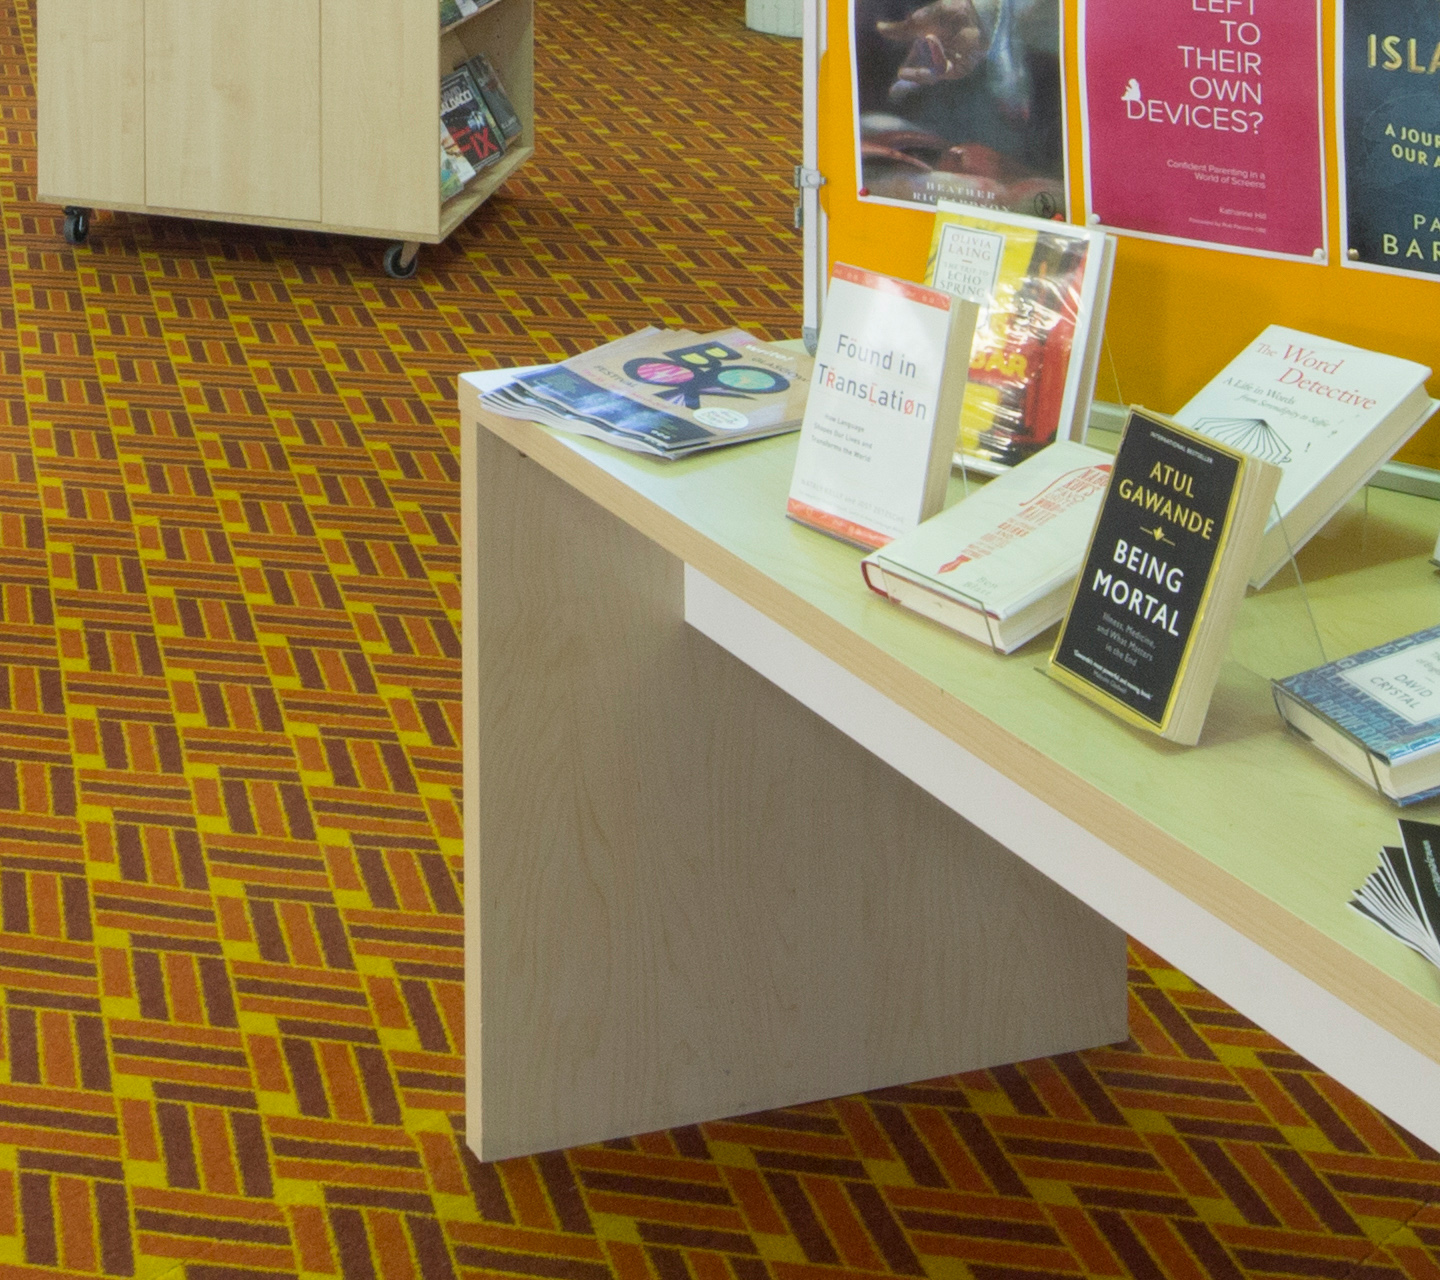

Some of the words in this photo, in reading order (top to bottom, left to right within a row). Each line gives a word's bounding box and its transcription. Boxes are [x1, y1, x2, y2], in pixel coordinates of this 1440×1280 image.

[1219, 20, 1261, 45] TO
[1178, 46, 1262, 75] THEIR
[1189, 76, 1262, 105] OWN
[1125, 98, 1264, 135] DEVICES?
[1385, 123, 1396, 137] A
[1391, 144, 1429, 167] OUR
[948, 243, 991, 262] LAING
[950, 233, 991, 249] OLIVIA
[939, 280, 985, 299] SPRING
[947, 271, 982, 286] ECHO
[899, 354, 917, 379] in
[1257, 342, 1277, 357] The
[1282, 344, 1345, 375] Word
[1277, 366, 1377, 410] Detective
[1149, 461, 1194, 499] ATUL
[1119, 478, 1215, 540] GAWANDE
[1113, 539, 1184, 593] BEING
[1092, 568, 1180, 637] MORTAL
[1370, 676, 1421, 710] CRYSTAL
[1394, 673, 1433, 698] DAVID
